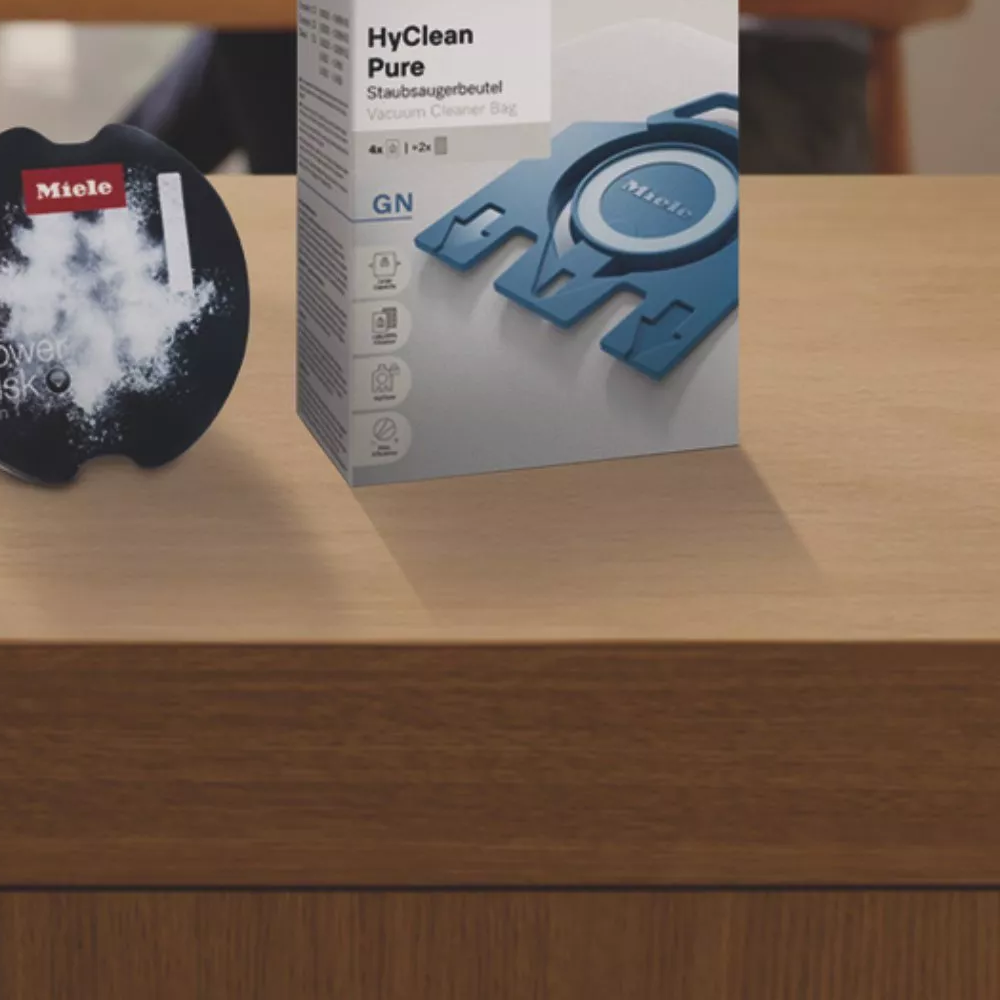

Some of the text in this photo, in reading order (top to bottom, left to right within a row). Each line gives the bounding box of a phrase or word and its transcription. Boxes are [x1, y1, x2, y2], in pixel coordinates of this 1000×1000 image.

[367, 24, 474, 52] HyClean
[367, 56, 426, 78] Pure
[366, 80, 504, 101] Staubsaugerbeutel
[366, 101, 519, 121] Vacuum Cleaner Bag
[368, 144, 384, 155] 4x
[36, 180, 114, 200] Miele
[621, 179, 693, 218] Miele
[372, 192, 414, 215] GN
